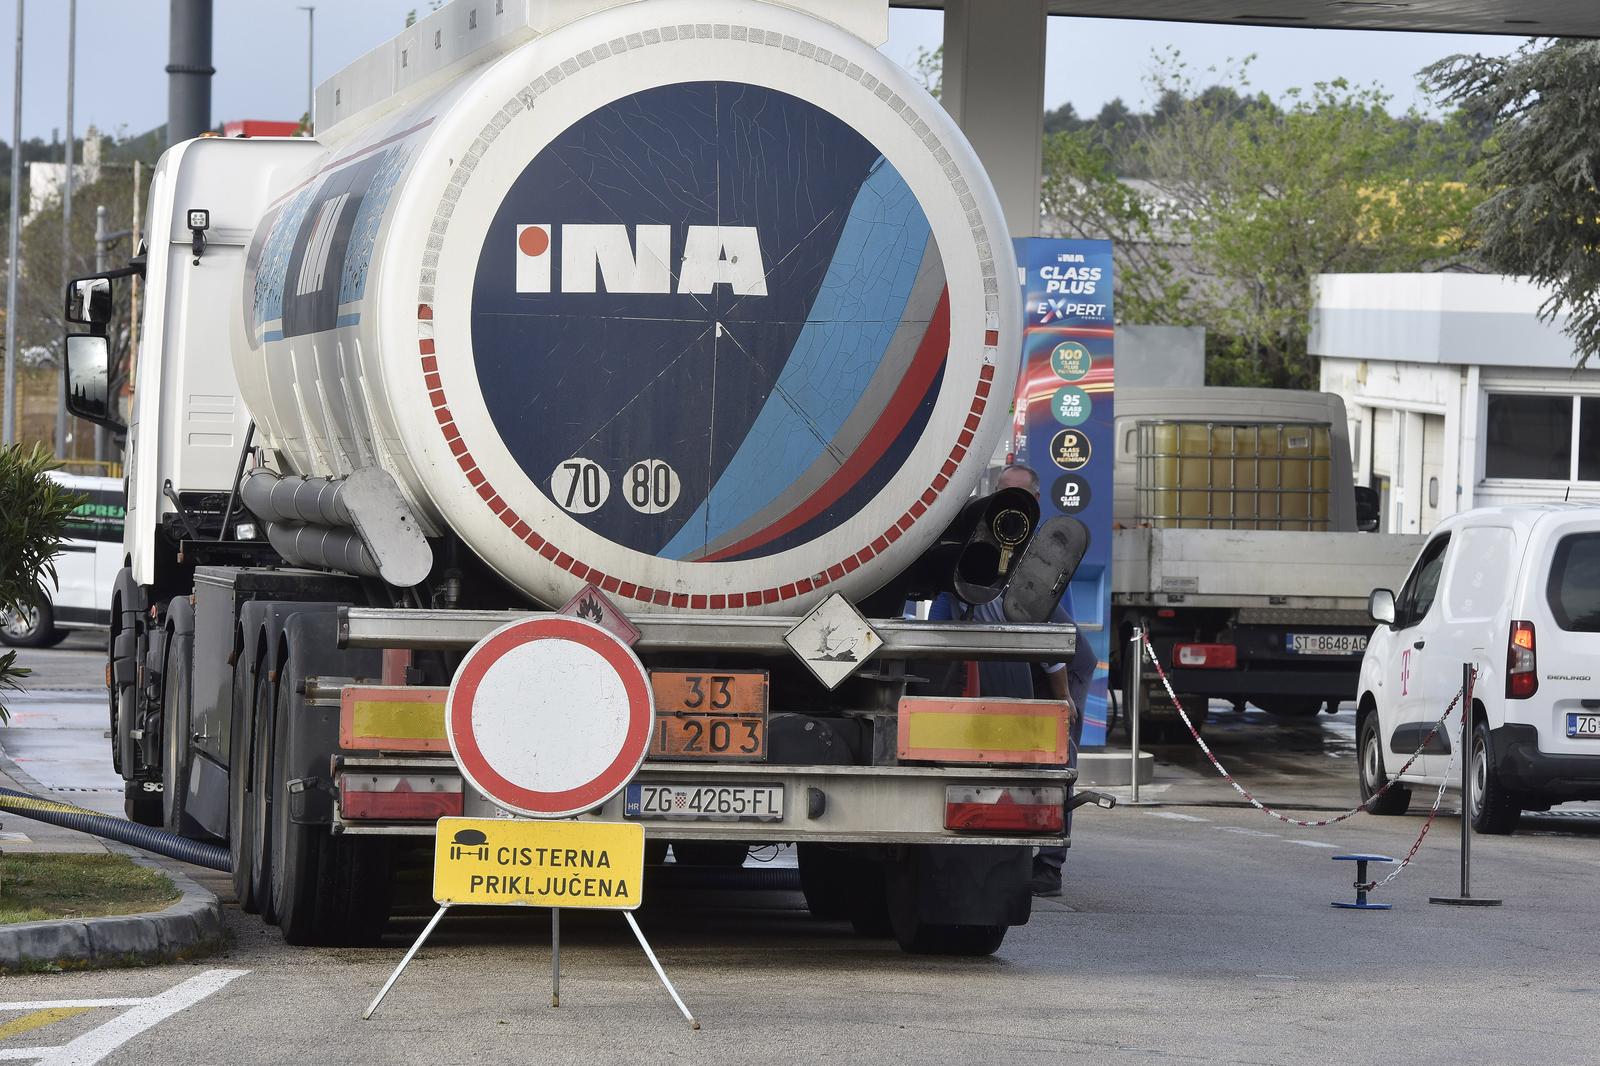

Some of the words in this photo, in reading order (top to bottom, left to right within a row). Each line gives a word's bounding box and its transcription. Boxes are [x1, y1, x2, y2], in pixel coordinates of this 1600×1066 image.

[1040, 266, 1102, 281] CLASS
[1046, 281, 1096, 295] PLUS
[1059, 349, 1082, 360] 100
[1062, 394, 1080, 406] 95
[1063, 434, 1078, 447] D
[563, 463, 601, 508] 70
[632, 463, 671, 508] 80
[1064, 482, 1079, 496] D
[1295, 636, 1310, 650] ST
[684, 676, 732, 710] 33
[1579, 718, 1597, 733] ZG
[660, 720, 760, 754] 1203
[643, 788, 672, 813] ZG
[497, 847, 611, 868] CISTERNA
[470, 873, 629, 898] PRIKLJUČENA
